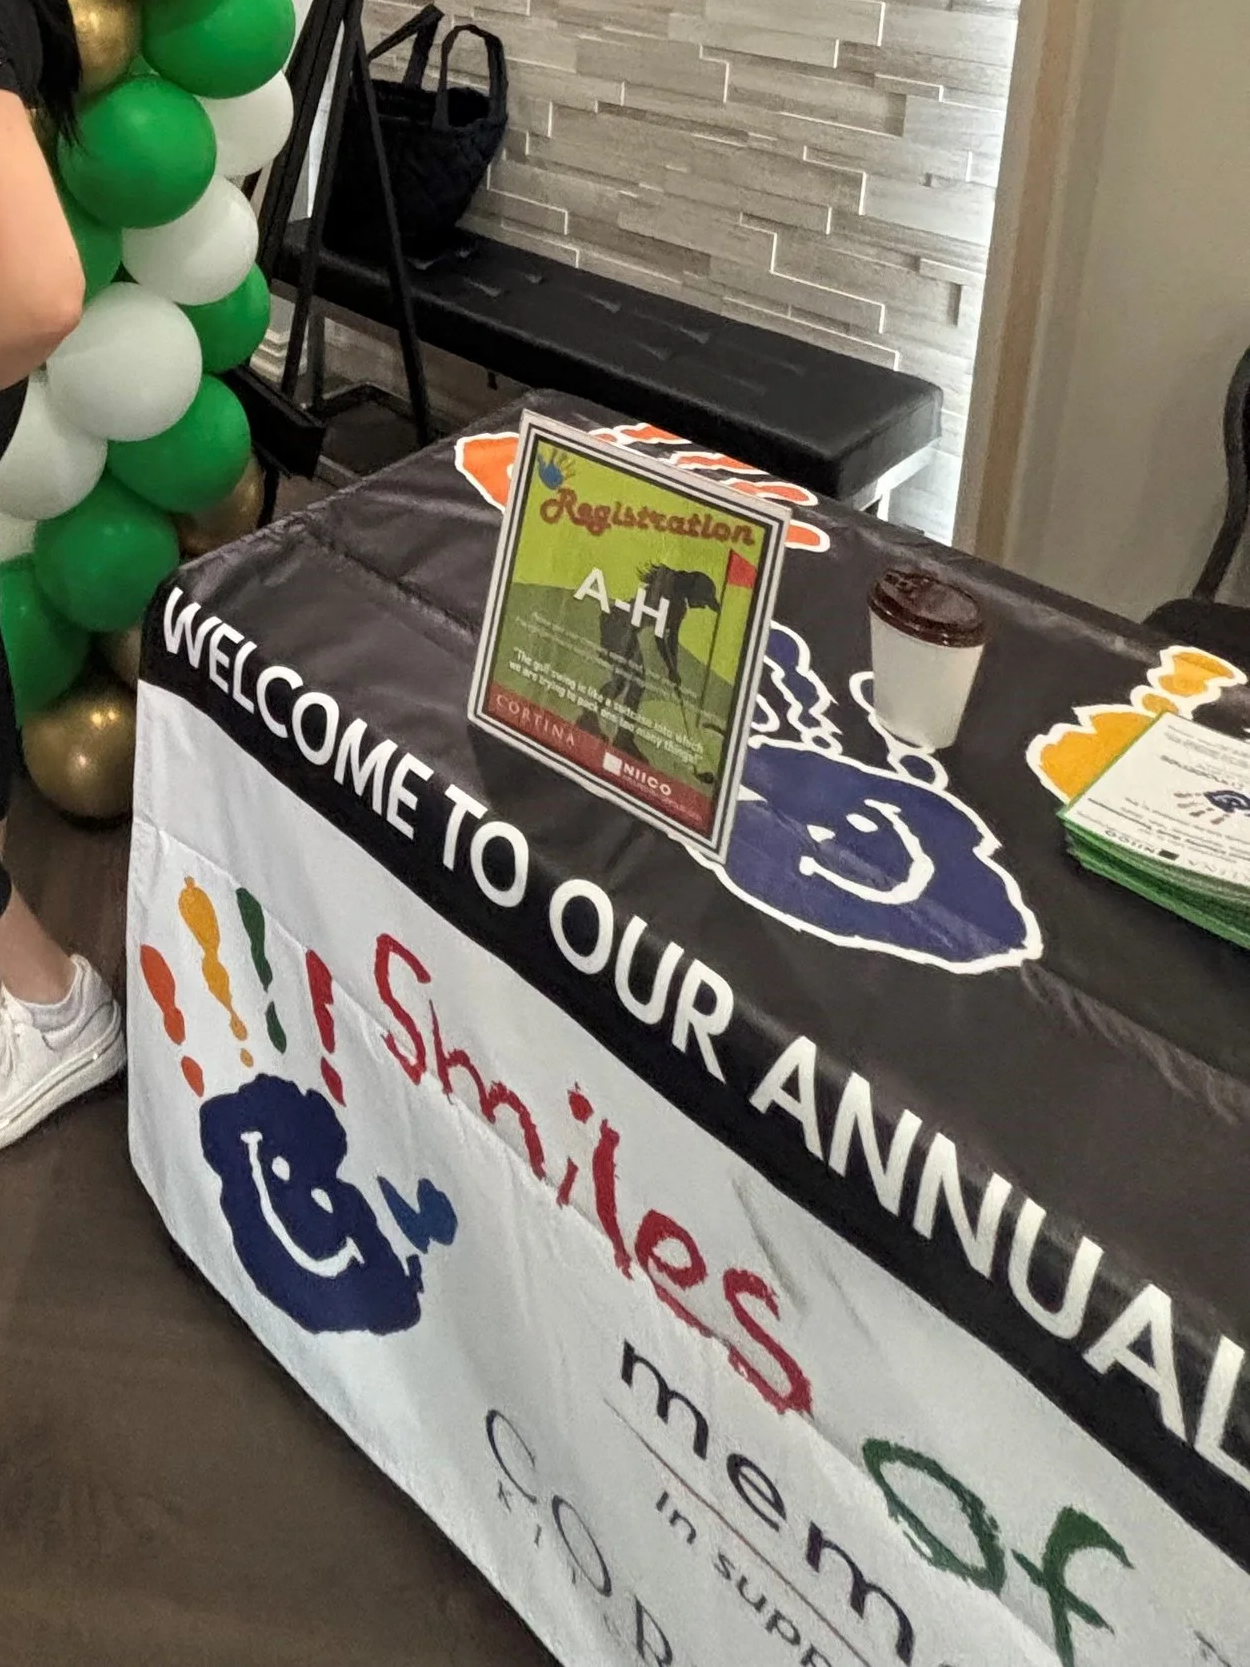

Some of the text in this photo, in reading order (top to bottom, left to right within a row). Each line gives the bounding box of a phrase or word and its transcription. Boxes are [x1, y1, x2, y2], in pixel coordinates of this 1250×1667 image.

[540, 487, 756, 546] Registration
[573, 567, 670, 638] A-H
[496, 694, 672, 796] CORTINA NIICO
[162, 587, 434, 840] WELCOME
[442, 784, 529, 907] TO
[549, 879, 734, 1084] OUR
[750, 1036, 1250, 1491] ANNUAL
[374, 932, 1135, 1667] Smiles of
[620, 1339, 953, 1667] mem
